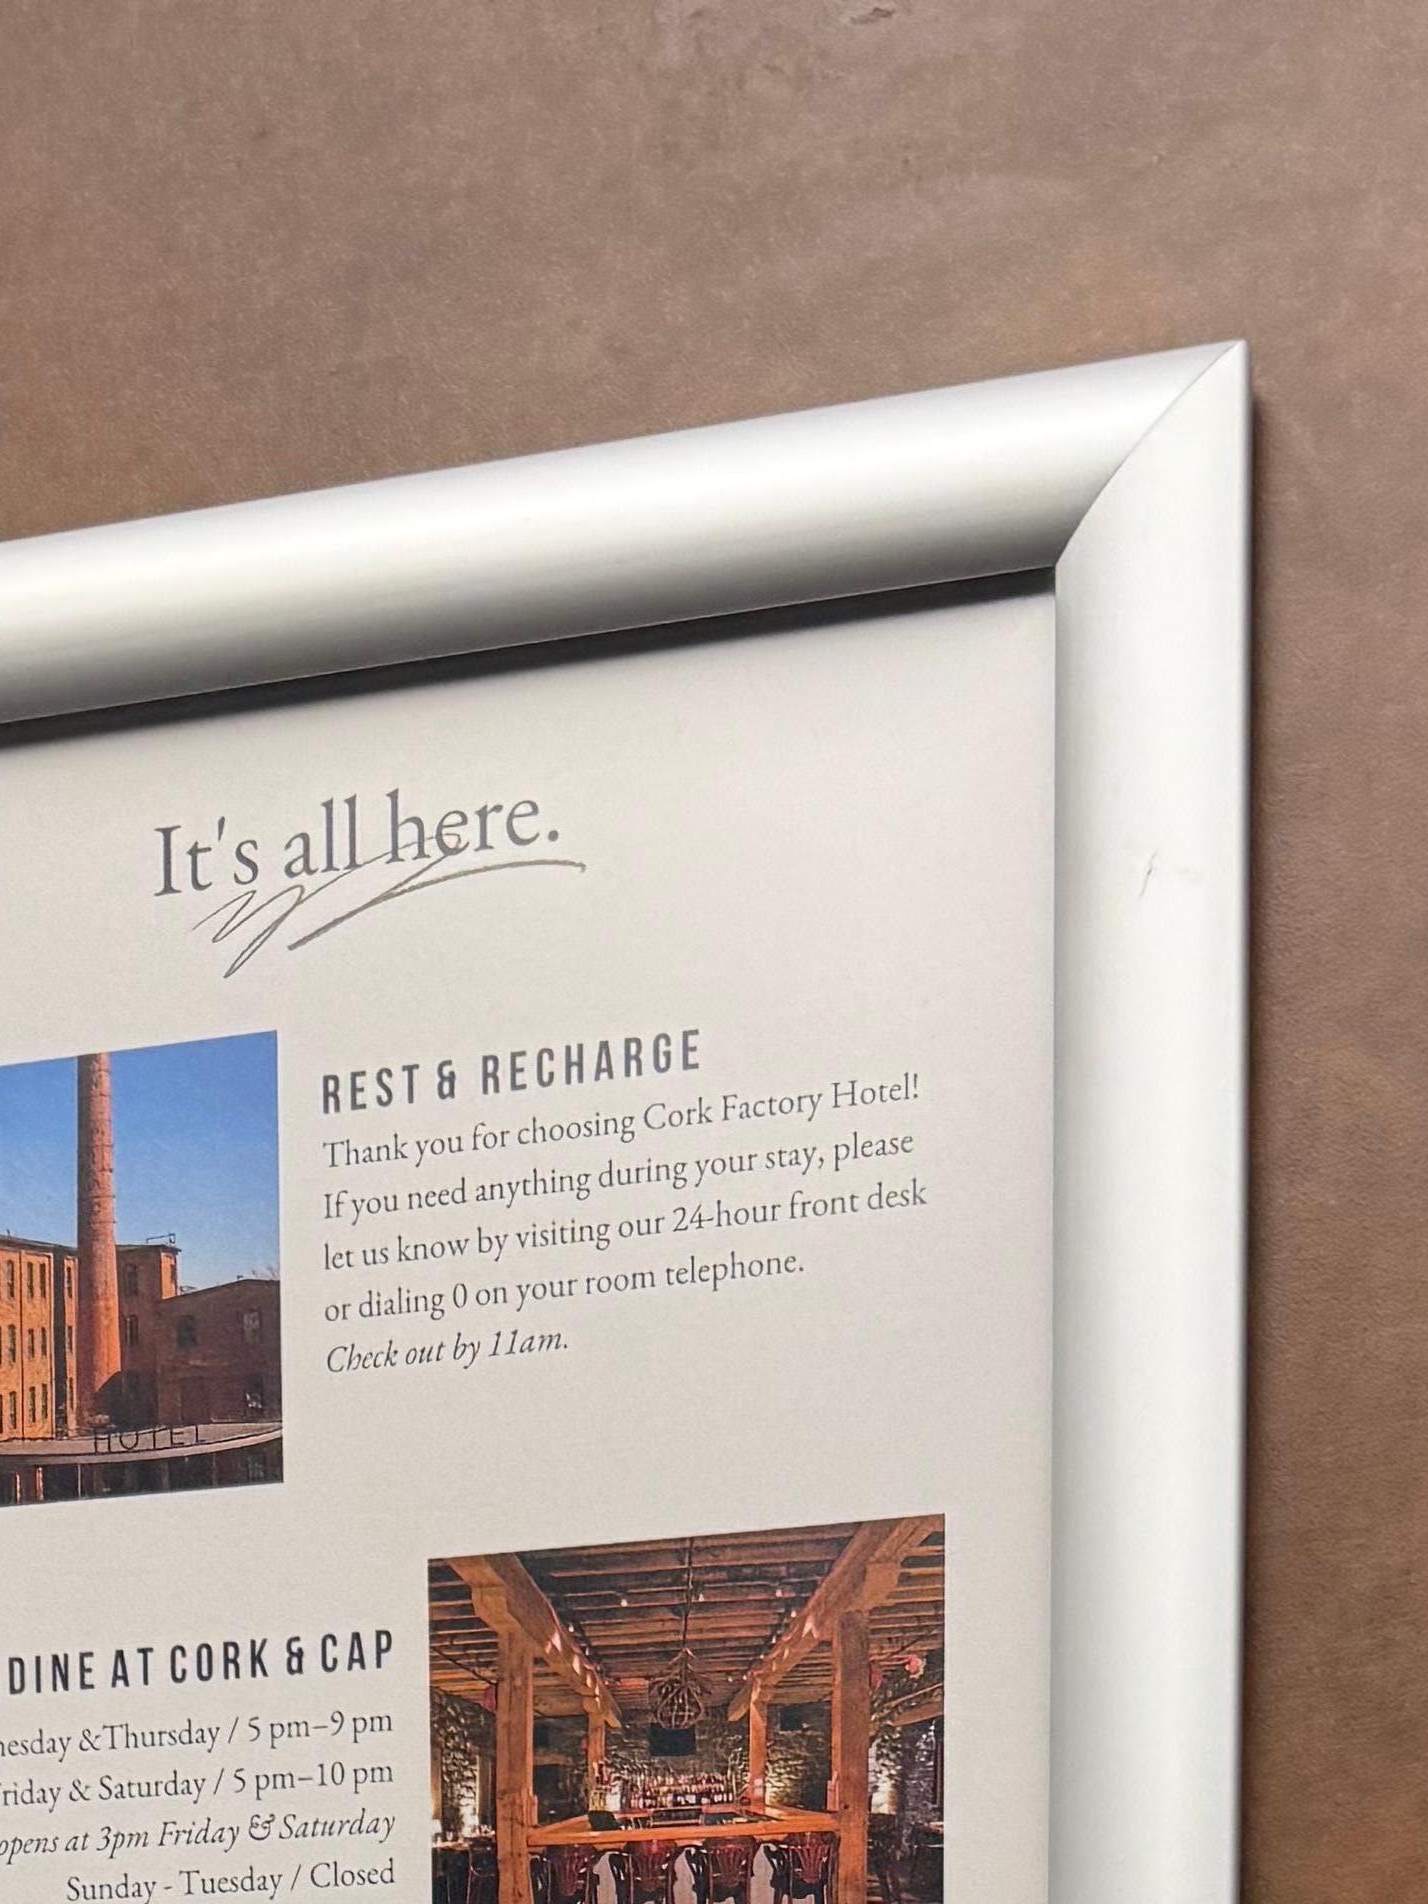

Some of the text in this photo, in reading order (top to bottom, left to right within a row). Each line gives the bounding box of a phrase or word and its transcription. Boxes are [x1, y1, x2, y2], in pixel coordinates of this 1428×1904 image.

[154, 788, 559, 897] It's all here.
[322, 1029, 699, 1115] REST & RECHARGE
[322, 1072, 918, 1168] Thank you for choosing Cork Factory Hotel!
[324, 1131, 913, 1226] If you need anything during your stay, please
[324, 1177, 927, 1270] let us know by visiting our 24-hour front desk
[325, 1251, 804, 1322] or dialing 0 on your room telephone.
[327, 1329, 568, 1373] Check out by 11am.
[8, 1651, 95, 1695] DINE
[111, 1647, 154, 1688] AT
[170, 1638, 269, 1684] CORK
[286, 1635, 305, 1676] &
[321, 1629, 392, 1673] CAP
[228, 1716, 239, 1744] /
[248, 1716, 261, 1742] 5
[352, 1715, 392, 1744] pm
[69, 1779, 91, 1802] &
[98, 1769, 206, 1805] Saturday
[213, 1768, 225, 1795] /
[233, 1768, 246, 1793] 5
[353, 1766, 393, 1795] pm
[64, 1832, 89, 1852] at
[96, 1826, 148, 1860] 3pm
[157, 1817, 240, 1853] Friday
[248, 1814, 276, 1841] &
[279, 1808, 396, 1845] Saturday
[179, 1865, 283, 1901] Tuesday
[290, 1864, 302, 1891] /
[310, 1857, 395, 1888] Closed
